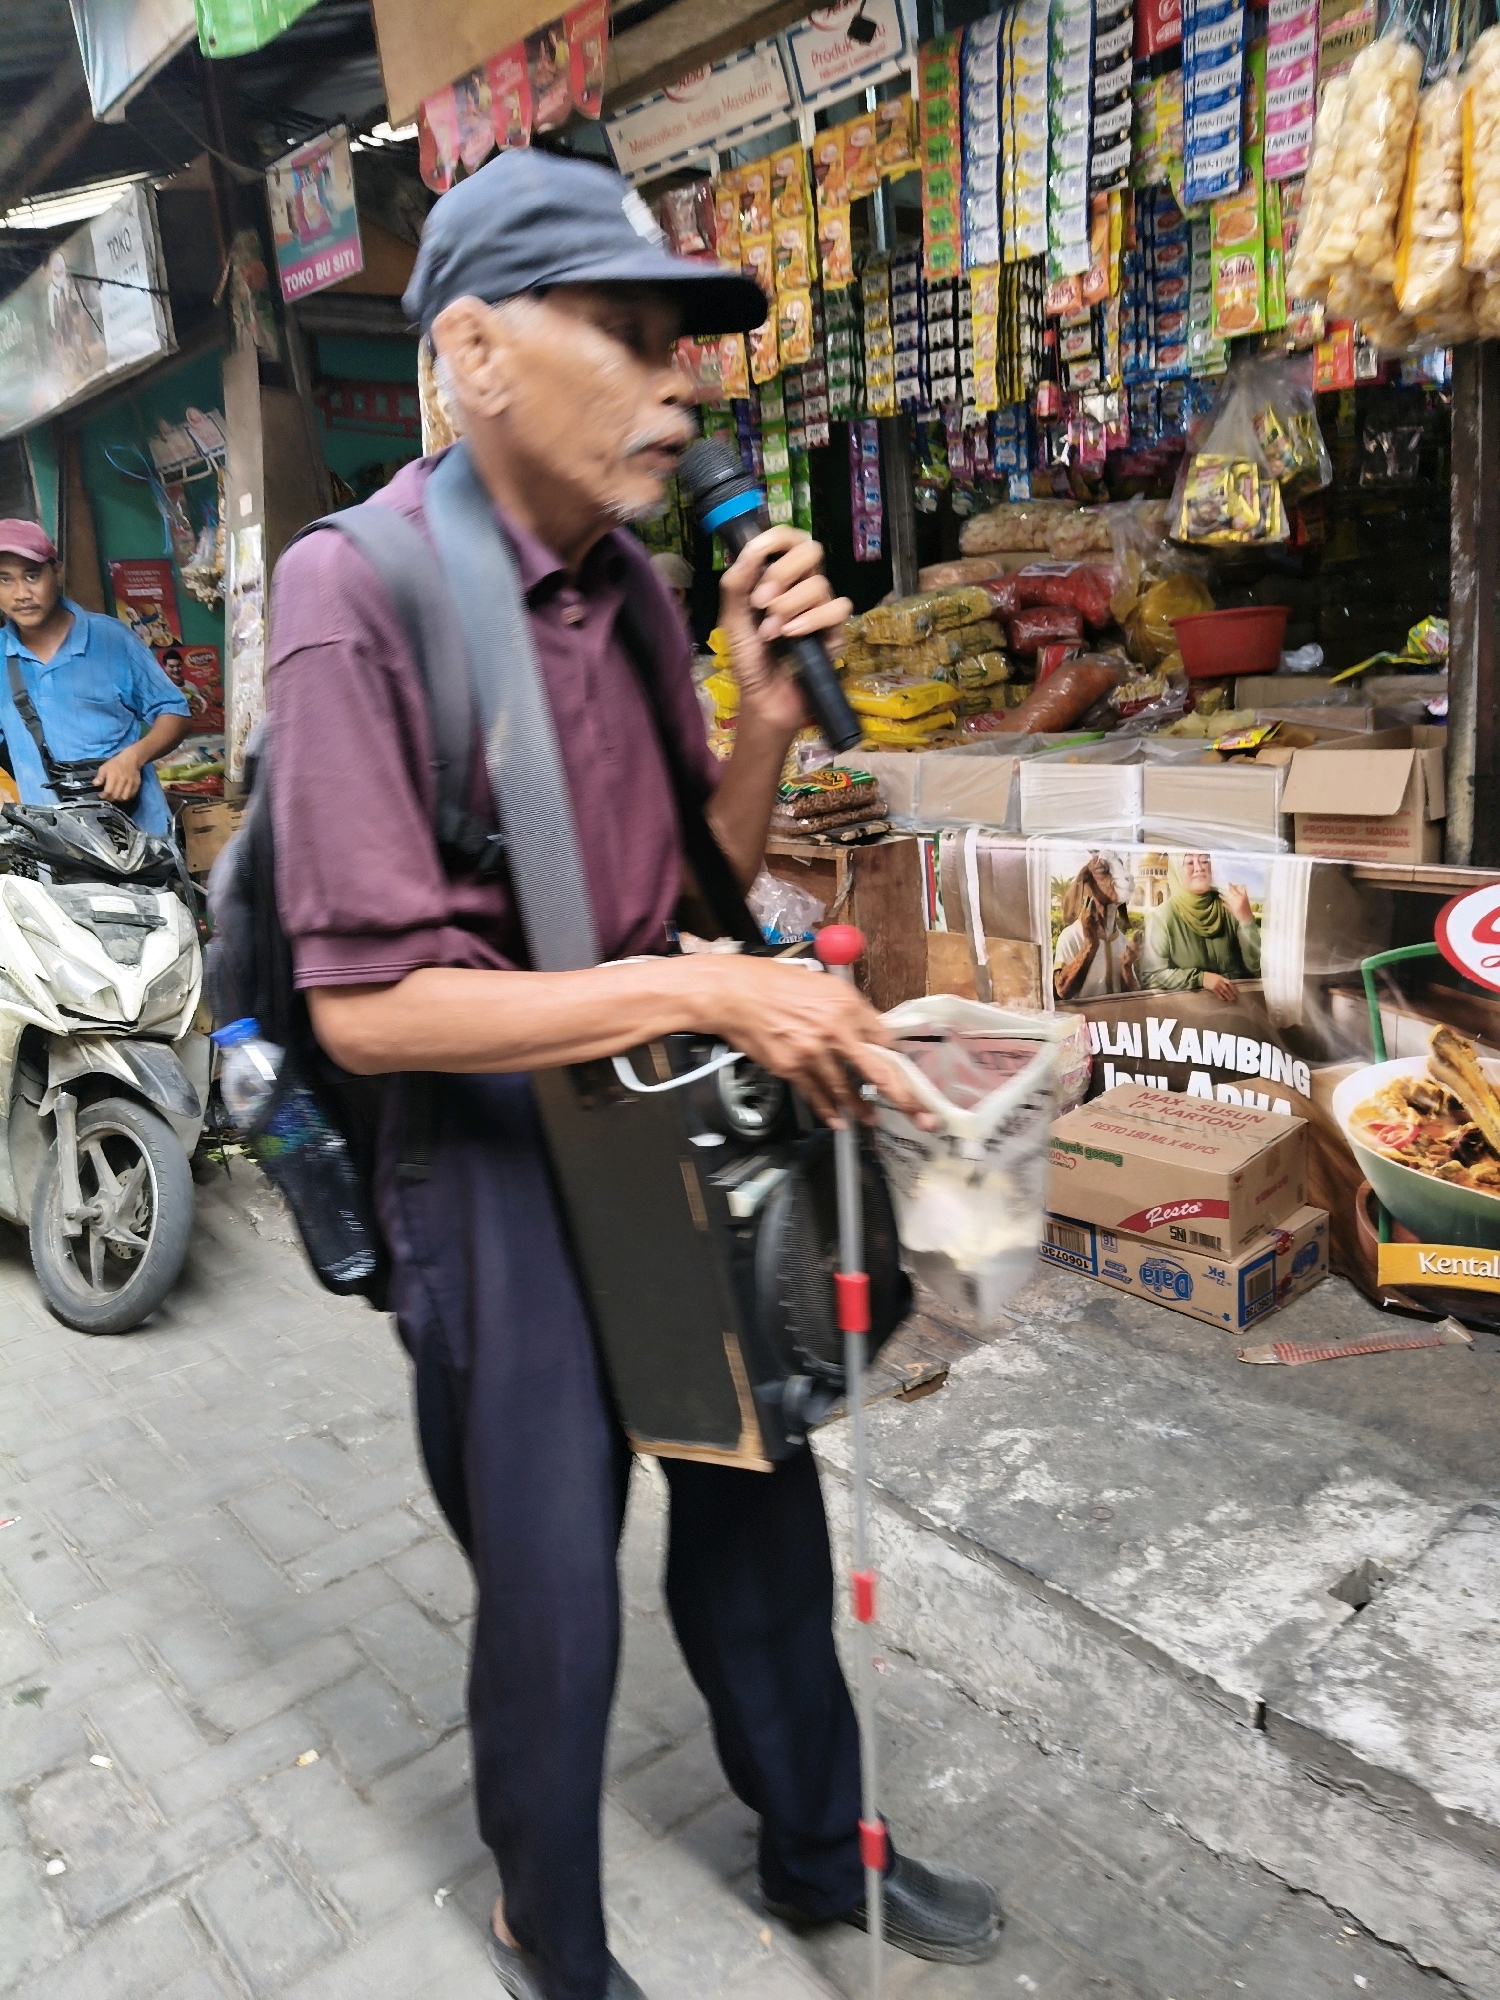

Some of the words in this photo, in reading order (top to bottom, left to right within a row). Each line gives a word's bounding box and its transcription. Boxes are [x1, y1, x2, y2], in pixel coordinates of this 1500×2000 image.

[1197, 26, 1239, 46] PANTENE
[1322, 25, 1368, 49] PANTENE
[1269, 40, 1311, 62] PANTENE
[1197, 69, 1238, 89] PANTENE
[721, 81, 774, 115] Masakan
[1268, 83, 1310, 105] PANTENE
[1196, 111, 1237, 130] PANTENE
[1267, 126, 1310, 149] PANTENE
[1195, 153, 1236, 172] PANTENE
[106, 226, 133, 263] TOKO
[284, 266, 314, 294] TOKO
[315, 259, 331, 281] BU
[332, 249, 356, 274] SITI
[1302, 824, 1356, 836] PRODUKSI
[1365, 826, 1409, 837] MADIUN
[1087, 1021, 1143, 1058] ULAI
[1146, 1016, 1311, 1099] KAMBING
[1137, 1091, 1185, 1107] MAX
[1196, 1104, 1267, 1124] SUSUN
[1157, 1106, 1247, 1131] KARTON)
[1090, 1121, 1127, 1135] RESTO
[1147, 1134, 1166, 1145] ML
[1167, 1139, 1178, 1147] X
[1193, 1145, 1220, 1155] PCS
[1084, 1146, 1124, 1168] goreng
[1145, 1202, 1201, 1227] Resto
[1168, 1225, 1187, 1243] SNI
[1208, 1265, 1226, 1279] PK
[1418, 1251, 1500, 1279] Kental
[1141, 1264, 1191, 1300] Daia
